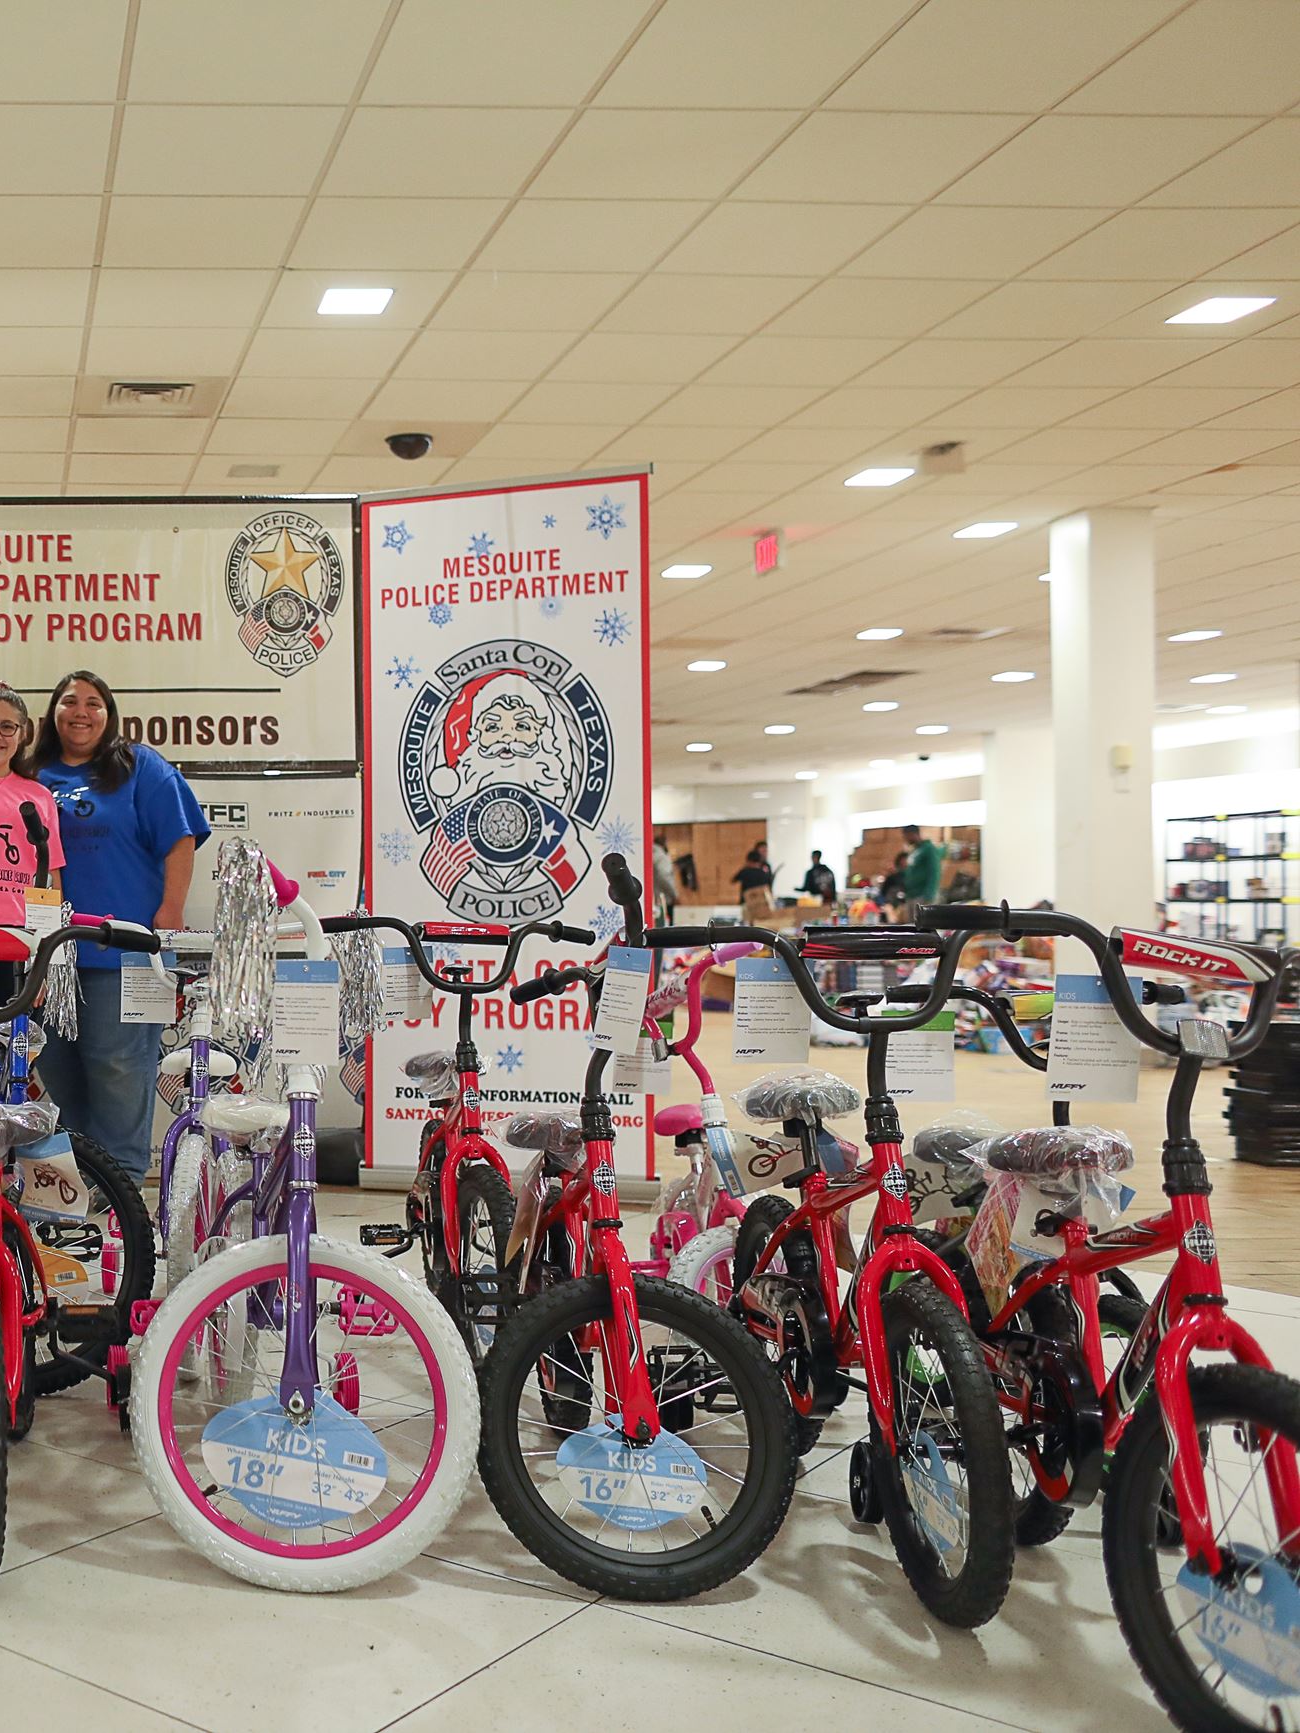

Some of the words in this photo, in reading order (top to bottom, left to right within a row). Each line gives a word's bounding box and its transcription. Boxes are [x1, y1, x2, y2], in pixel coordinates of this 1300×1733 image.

[253, 515, 315, 533] OFFICER
[230, 543, 247, 606] MESQUITE
[324, 544, 339, 597] TEXAS
[443, 549, 561, 579] MESQUITE
[381, 583, 459, 609] POLICE
[470, 570, 629, 603] DEPARTMENT
[47, 612, 202, 642] PROGRAM
[258, 649, 314, 665] POLICE
[441, 650, 508, 685] Santa
[513, 643, 563, 679] Cop
[122, 714, 280, 746] ponsors
[406, 700, 435, 815] MESQUITE
[576, 696, 606, 793] TEXAS
[473, 790, 501, 813] STATE
[509, 790, 525, 801] OF
[303, 809, 355, 817] INDUSTRIES
[527, 802, 539, 842] TEXAS
[471, 819, 480, 841] THE
[459, 891, 555, 919] POLICE
[1059, 992, 1076, 1000] KIDS
[479, 1088, 581, 1105] NFORMATION
[887, 1088, 914, 1096] HUFFY
[1051, 1082, 1087, 1091] HUFFY
[227, 1447, 247, 1455] Wheel
[265, 1428, 327, 1459] KIDS
[227, 1456, 284, 1489] 18"
[608, 1451, 657, 1473] KIDS
[580, 1476, 626, 1501] 16"
